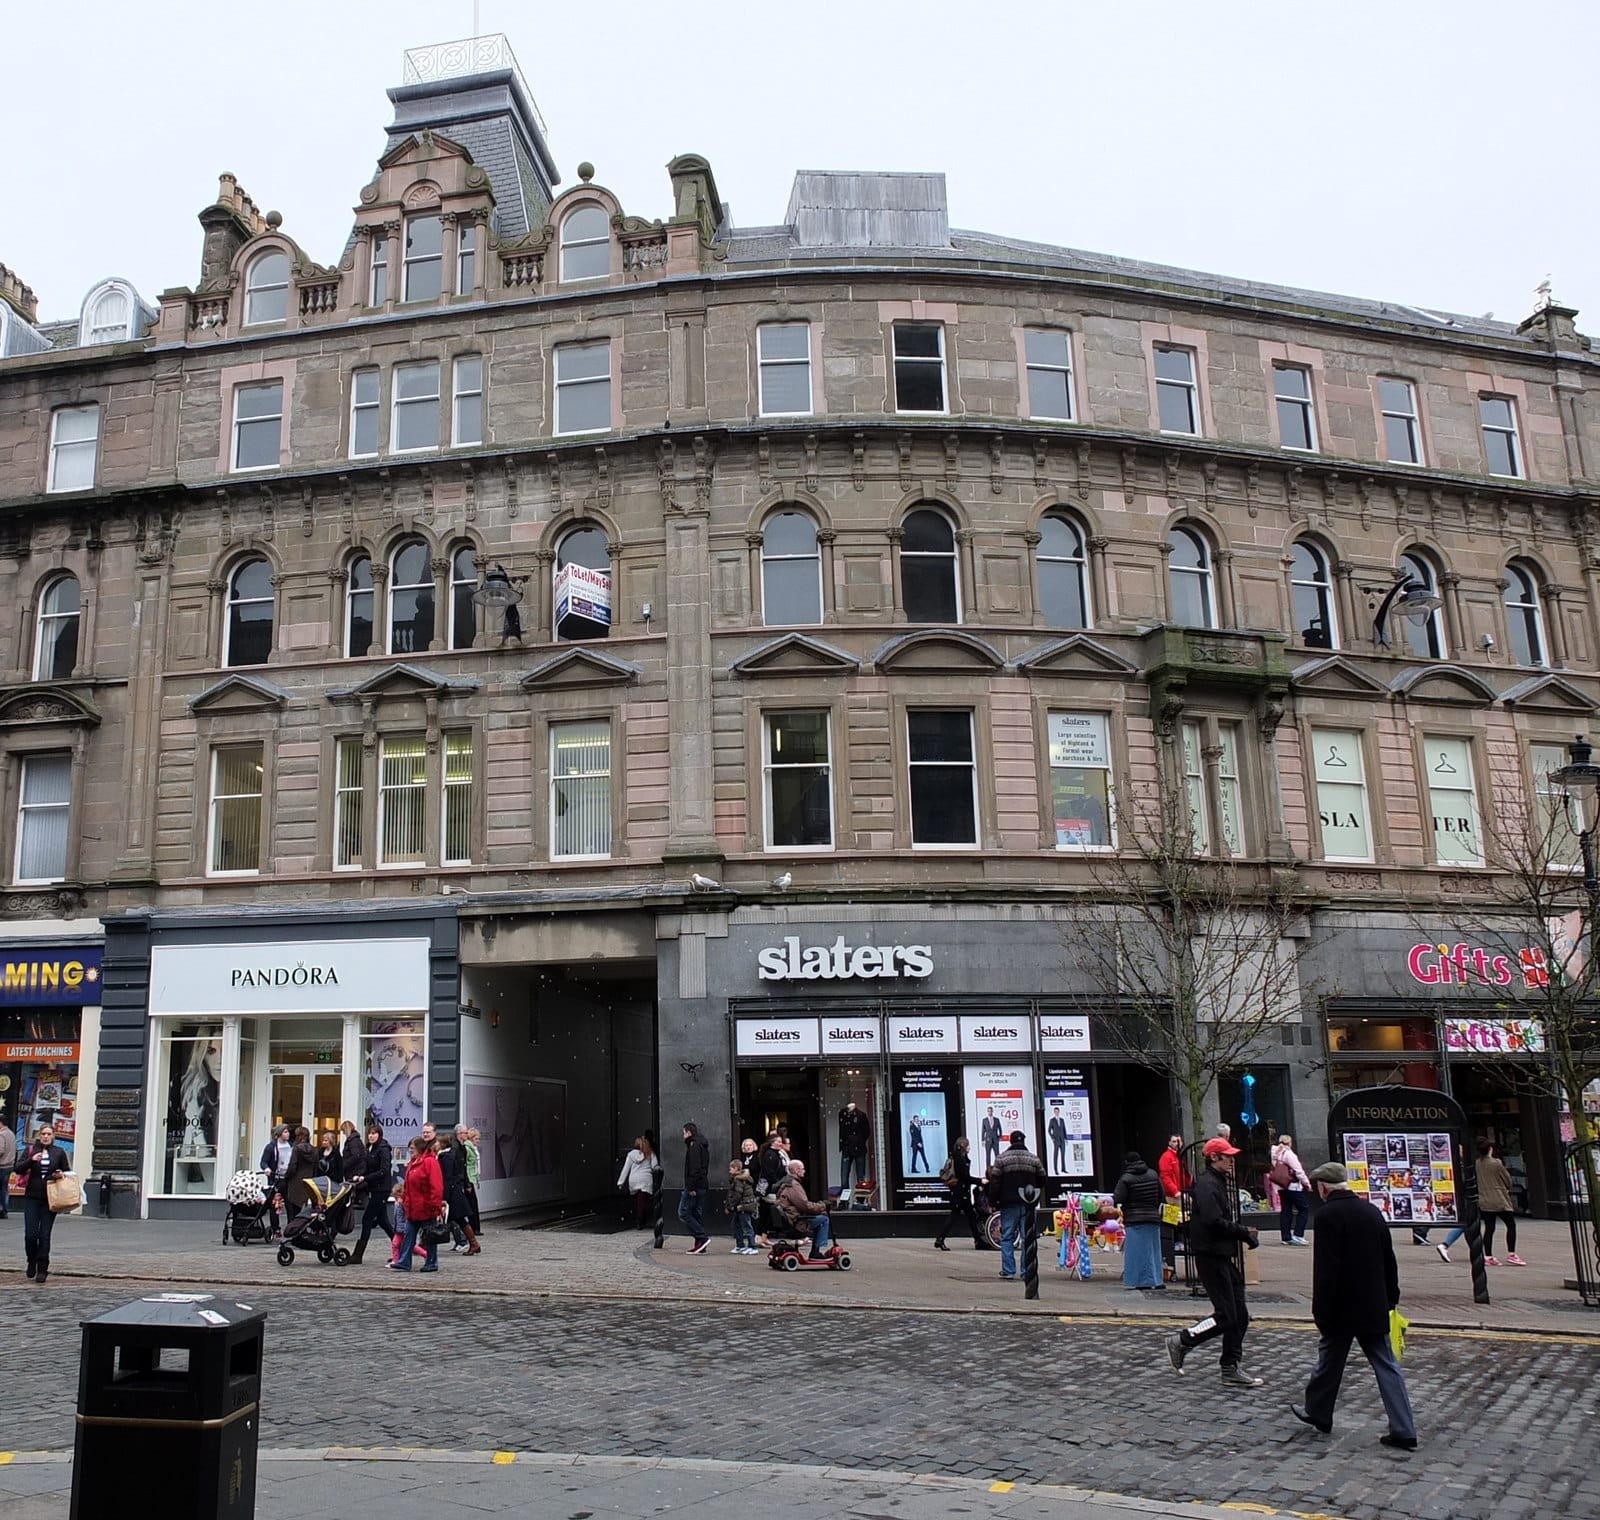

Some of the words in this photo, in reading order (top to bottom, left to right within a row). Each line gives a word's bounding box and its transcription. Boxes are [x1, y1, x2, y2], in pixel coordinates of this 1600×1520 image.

[1061, 717, 1091, 726] slaters
[1319, 812, 1360, 828] SLA
[1433, 816, 1471, 833] TER
[758, 936, 934, 980] slaters
[1407, 943, 1512, 986] Gifts
[0, 961, 84, 986] MING
[231, 965, 339, 987] PANDORA
[755, 1028, 801, 1041] slaters
[828, 1028, 874, 1040] slaters
[898, 1027, 944, 1039] slaters
[973, 1026, 1018, 1038] slaters
[1040, 1026, 1084, 1038] slaters
[1444, 1022, 1503, 1048] Gifts
[6, 1046, 34, 1057] LATEST
[34, 1046, 73, 1057] MACHINES
[1346, 1107, 1449, 1121] INFORMATION
[163, 1118, 214, 1127] PDORA
[364, 1117, 418, 1127] PANDORA
[918, 1118, 941, 1126] aters
